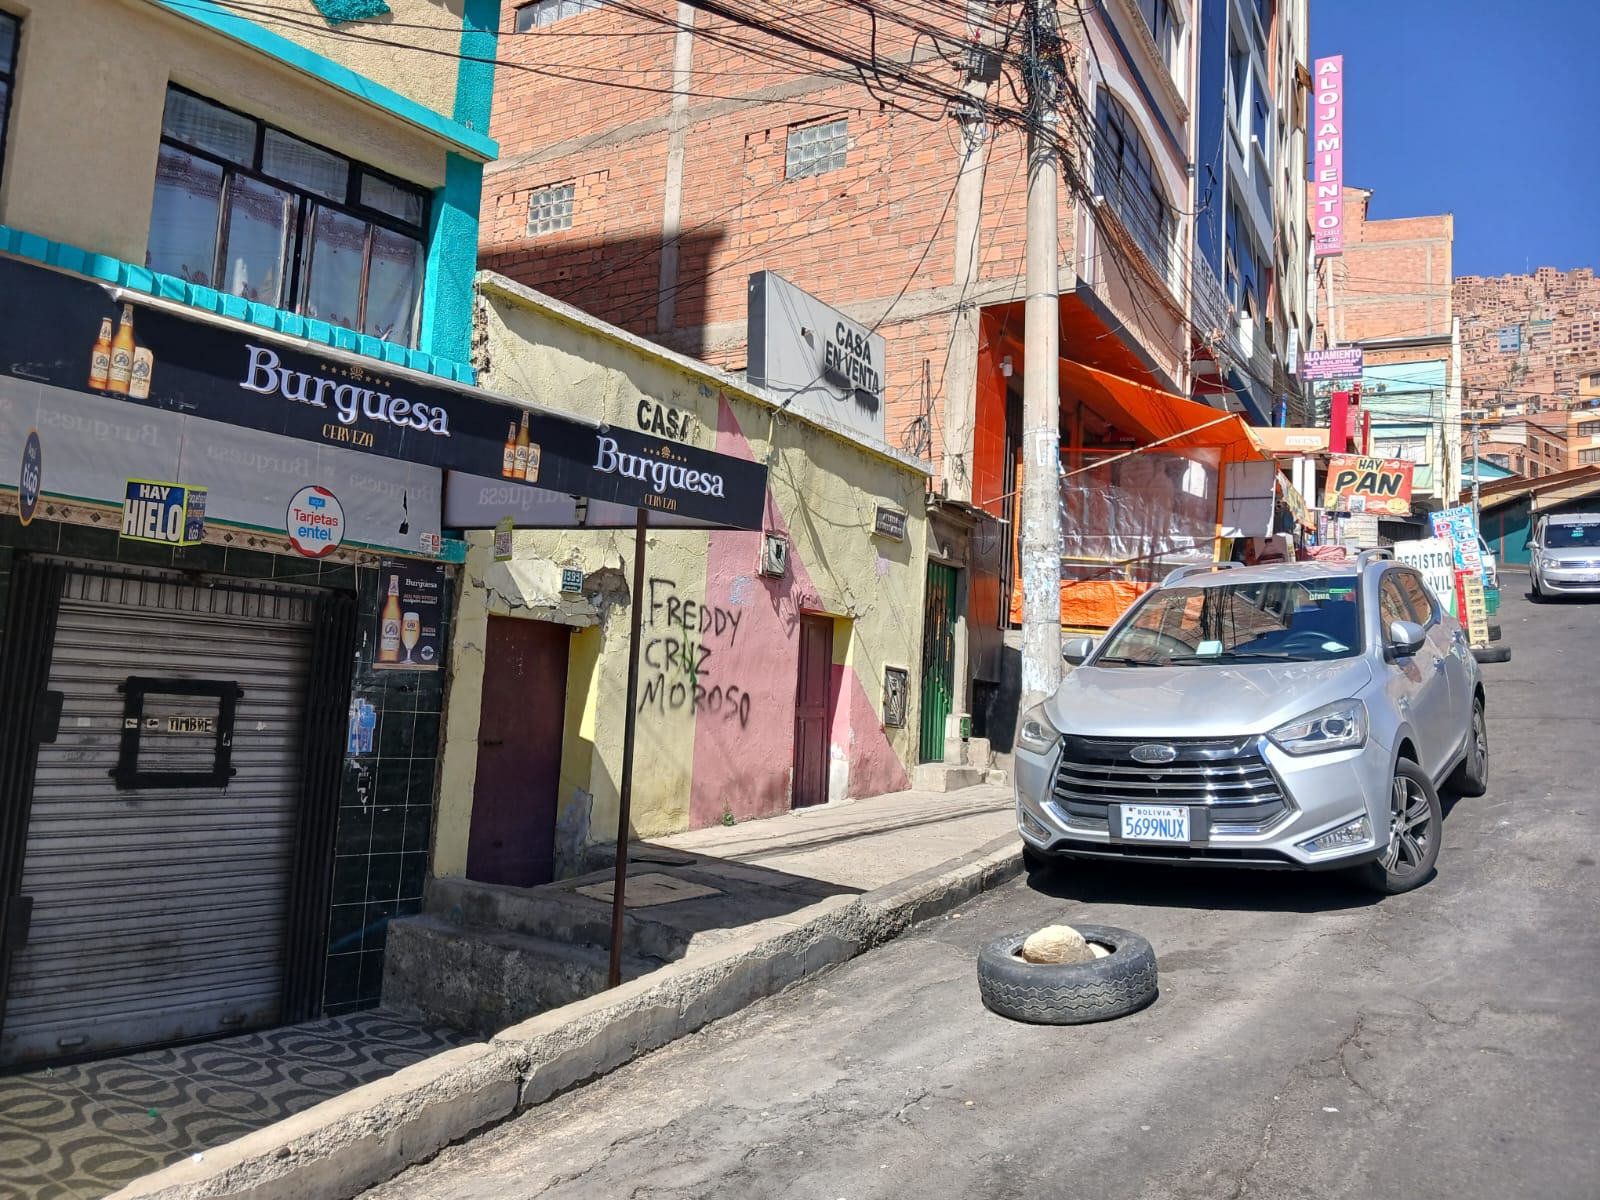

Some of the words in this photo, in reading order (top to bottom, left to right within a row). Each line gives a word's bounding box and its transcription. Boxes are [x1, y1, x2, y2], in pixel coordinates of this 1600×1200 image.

[1317, 61, 1340, 229] ALOJAMIENTO
[836, 321, 871, 366] CASA
[1304, 349, 1362, 361] ALOJAMIENTO
[826, 340, 841, 371] EN
[845, 352, 879, 396] VENTA
[239, 344, 451, 437] Burguesa
[322, 424, 374, 448] CERVEZA
[593, 435, 725, 498] Burguesa
[1358, 459, 1383, 470] HAY
[140, 484, 170, 501] HAY
[1335, 471, 1402, 496] PAN
[294, 508, 338, 526] Tarjetas
[644, 493, 677, 511] CERVEZA
[122, 499, 183, 542] HIELO
[298, 525, 332, 541] entel
[649, 578, 742, 647] FREDDY
[645, 638, 711, 675] CRUZ
[638, 673, 750, 729] MOROSO
[1126, 817, 1184, 838] 5699NUX
